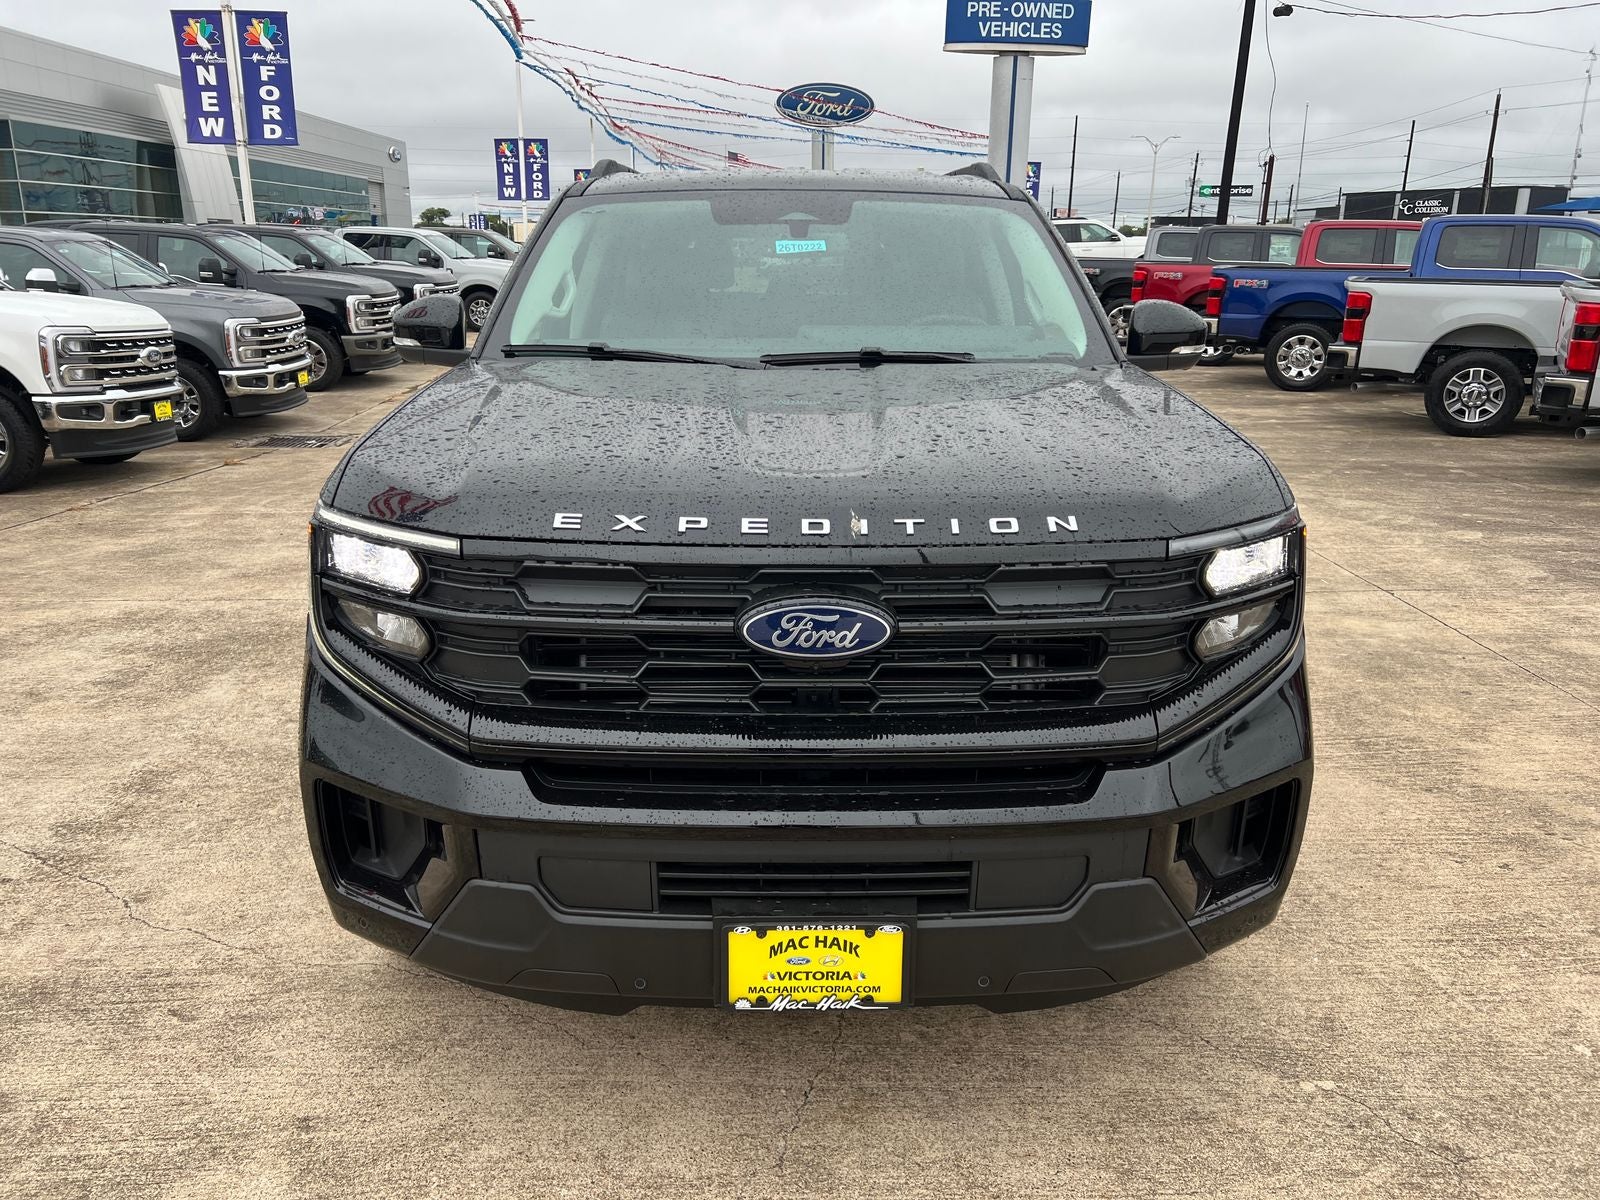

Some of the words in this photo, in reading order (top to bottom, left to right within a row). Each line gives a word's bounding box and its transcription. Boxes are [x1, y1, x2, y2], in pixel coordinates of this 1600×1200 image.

[966, 1, 1075, 20] PRE-OWNED
[978, 21, 1063, 39] VEHICLES
[195, 65, 225, 138] NEW
[258, 65, 283, 139] FORD
[797, 91, 855, 117] Ford
[503, 163, 516, 198] NEW
[532, 163, 543, 199] FORD
[778, 243, 823, 252] 26T0222
[1233, 279, 1269, 289] FX4
[552, 512, 1079, 535] EXPEDITION
[772, 612, 862, 650] Ford
[769, 936, 809, 959] MAC
[815, 935, 860, 958] HAIK
[776, 970, 853, 981] VICTORIA
[748, 985, 881, 994] MACHAIKVICTORIA.COM
[770, 995, 813, 1011] Mac
[815, 995, 863, 1011] Haik
